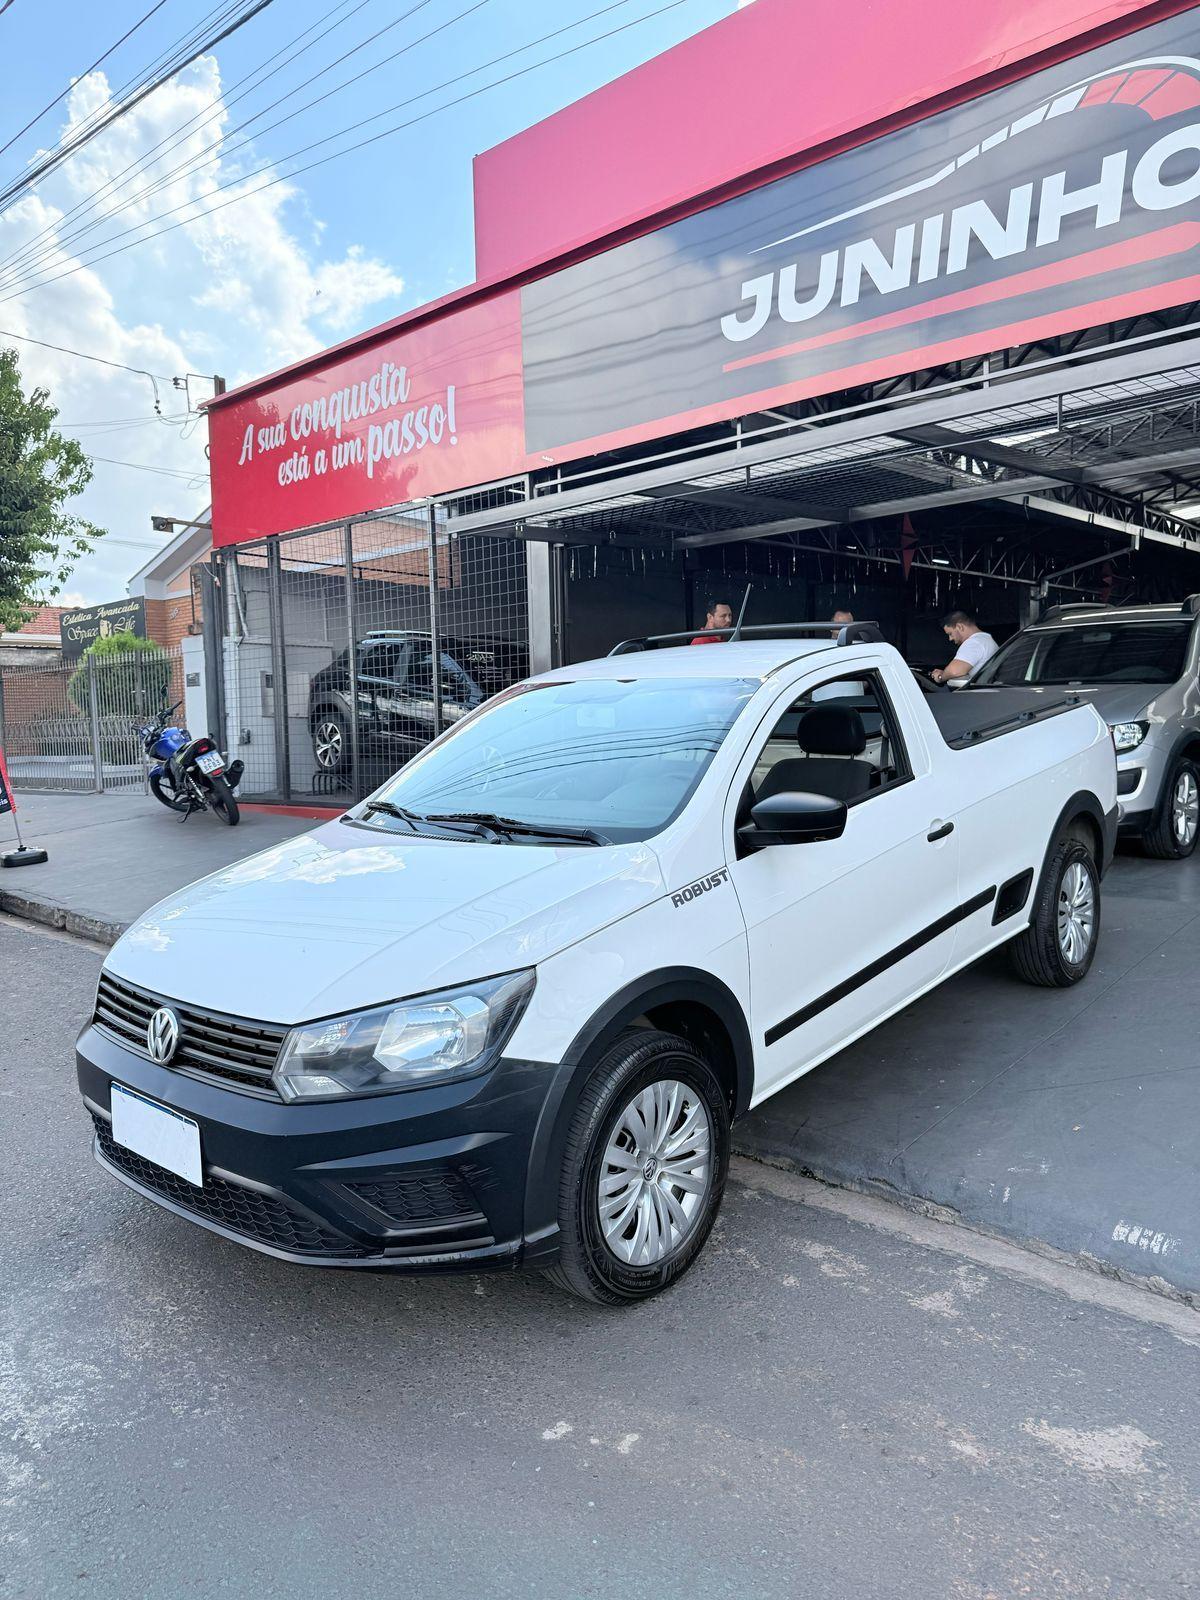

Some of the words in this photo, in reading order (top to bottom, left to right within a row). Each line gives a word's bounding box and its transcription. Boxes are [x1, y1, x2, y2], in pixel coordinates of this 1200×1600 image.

[720, 123, 1200, 342] JUNINHO
[238, 423, 254, 466] A
[257, 420, 287, 454] sua
[278, 445, 311, 487] está
[314, 449, 328, 476] a
[332, 436, 365, 471] um
[366, 385, 458, 479] passo!
[67, 626, 98, 643] Space
[671, 869, 728, 908] ROBUST
